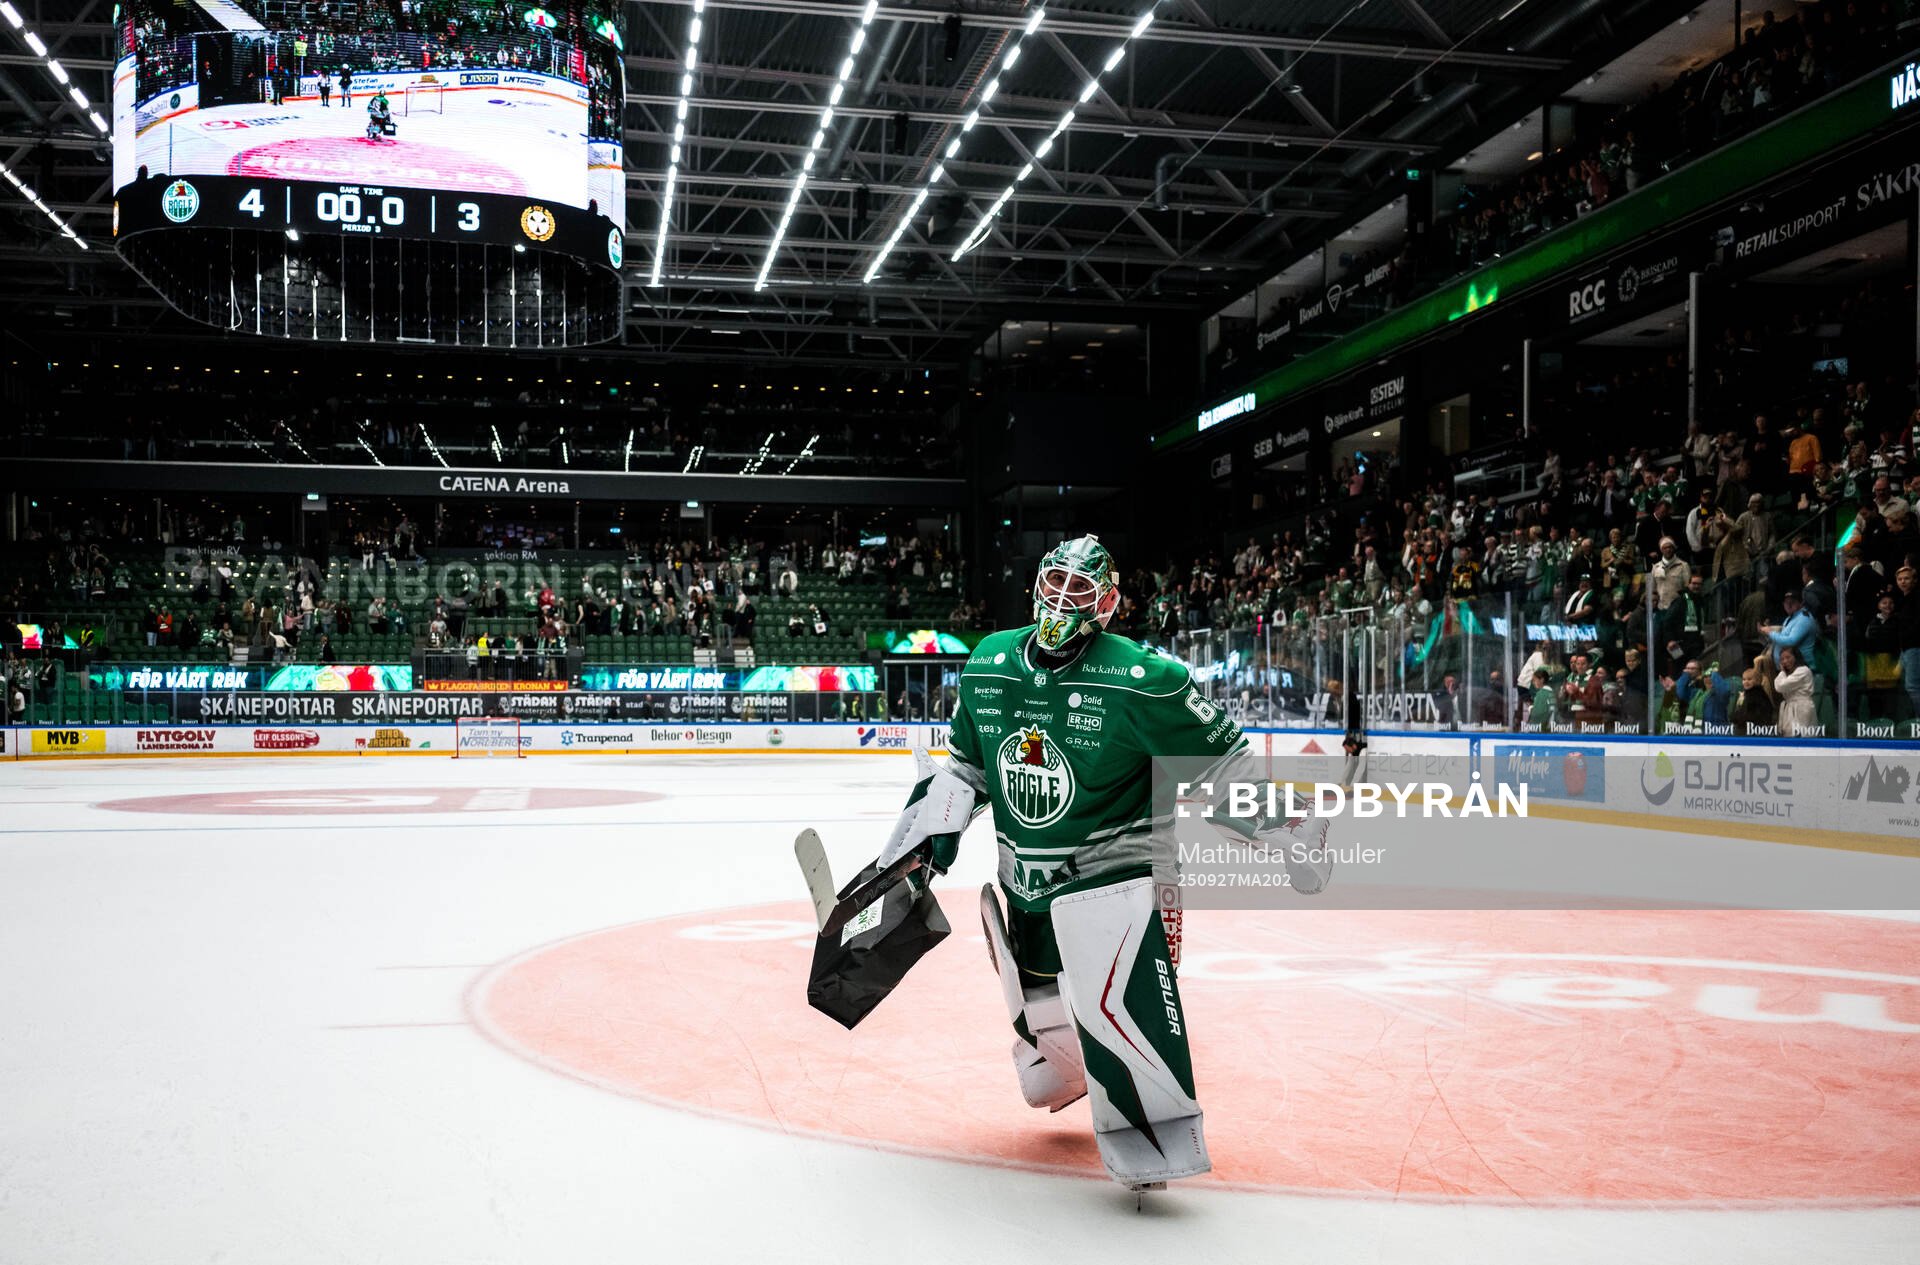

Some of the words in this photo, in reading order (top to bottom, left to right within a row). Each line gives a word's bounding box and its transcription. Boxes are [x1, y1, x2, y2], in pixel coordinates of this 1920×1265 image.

[339, 186, 360, 195] GAME
[363, 188, 383, 196] TIME
[238, 188, 265, 217] 4
[317, 192, 405, 226] 00.0
[457, 202, 481, 231] 3
[342, 223, 371, 233] PERIOD
[374, 225, 381, 233] 3
[1569, 279, 1606, 318] RCC
[1254, 438, 1273, 460] SEB
[439, 476, 511, 493] CATENA
[515, 480, 571, 494] Arena
[522, 551, 538, 560] RM
[129, 667, 161, 688] FÖR
[164, 666, 209, 688] VÅRT
[211, 671, 249, 688] RBK
[1081, 663, 1129, 677] Backahill
[616, 669, 649, 689] FÖR
[650, 667, 690, 689] VÅRT
[691, 672, 727, 689] RBK
[513, 682, 551, 691] KRONAN
[200, 693, 336, 716] SKÅNEPORTAR
[351, 693, 484, 716] SKÅNEPORTAR
[511, 694, 557, 707] STÄDAX
[1082, 694, 1103, 706] Solid
[1022, 711, 1054, 722] Liljedahl
[1069, 716, 1100, 728] ER-HO
[878, 728, 907, 737] INTER
[1521, 721, 1542, 733] Boozt
[1550, 721, 1572, 733] Boozt
[1581, 721, 1605, 734] Boozt
[1614, 721, 1640, 735] Boozt
[1703, 722, 1734, 736] Boozt
[1746, 722, 1778, 737] Boozt
[1791, 723, 1826, 738] Boozt
[1857, 723, 1894, 738] Boozt
[47, 731, 80, 745] MVB
[137, 730, 216, 742] FLYTGOLV
[255, 733, 270, 743] LEIF
[376, 729, 400, 740] EURO
[576, 732, 634, 747] Tranpenad
[651, 729, 684, 745] Dekor
[696, 728, 733, 744] Design
[142, 742, 199, 751] LANDSKRONA
[202, 742, 214, 751] AB
[877, 737, 907, 748] SPORT
[1065, 736, 1101, 749] GRAM
[1508, 750, 1549, 785] Marlene
[1684, 753, 1794, 796] BJÄRE
[1005, 768, 1062, 806] RÖGLE
[1684, 796, 1795, 818] MARKKONSULT
